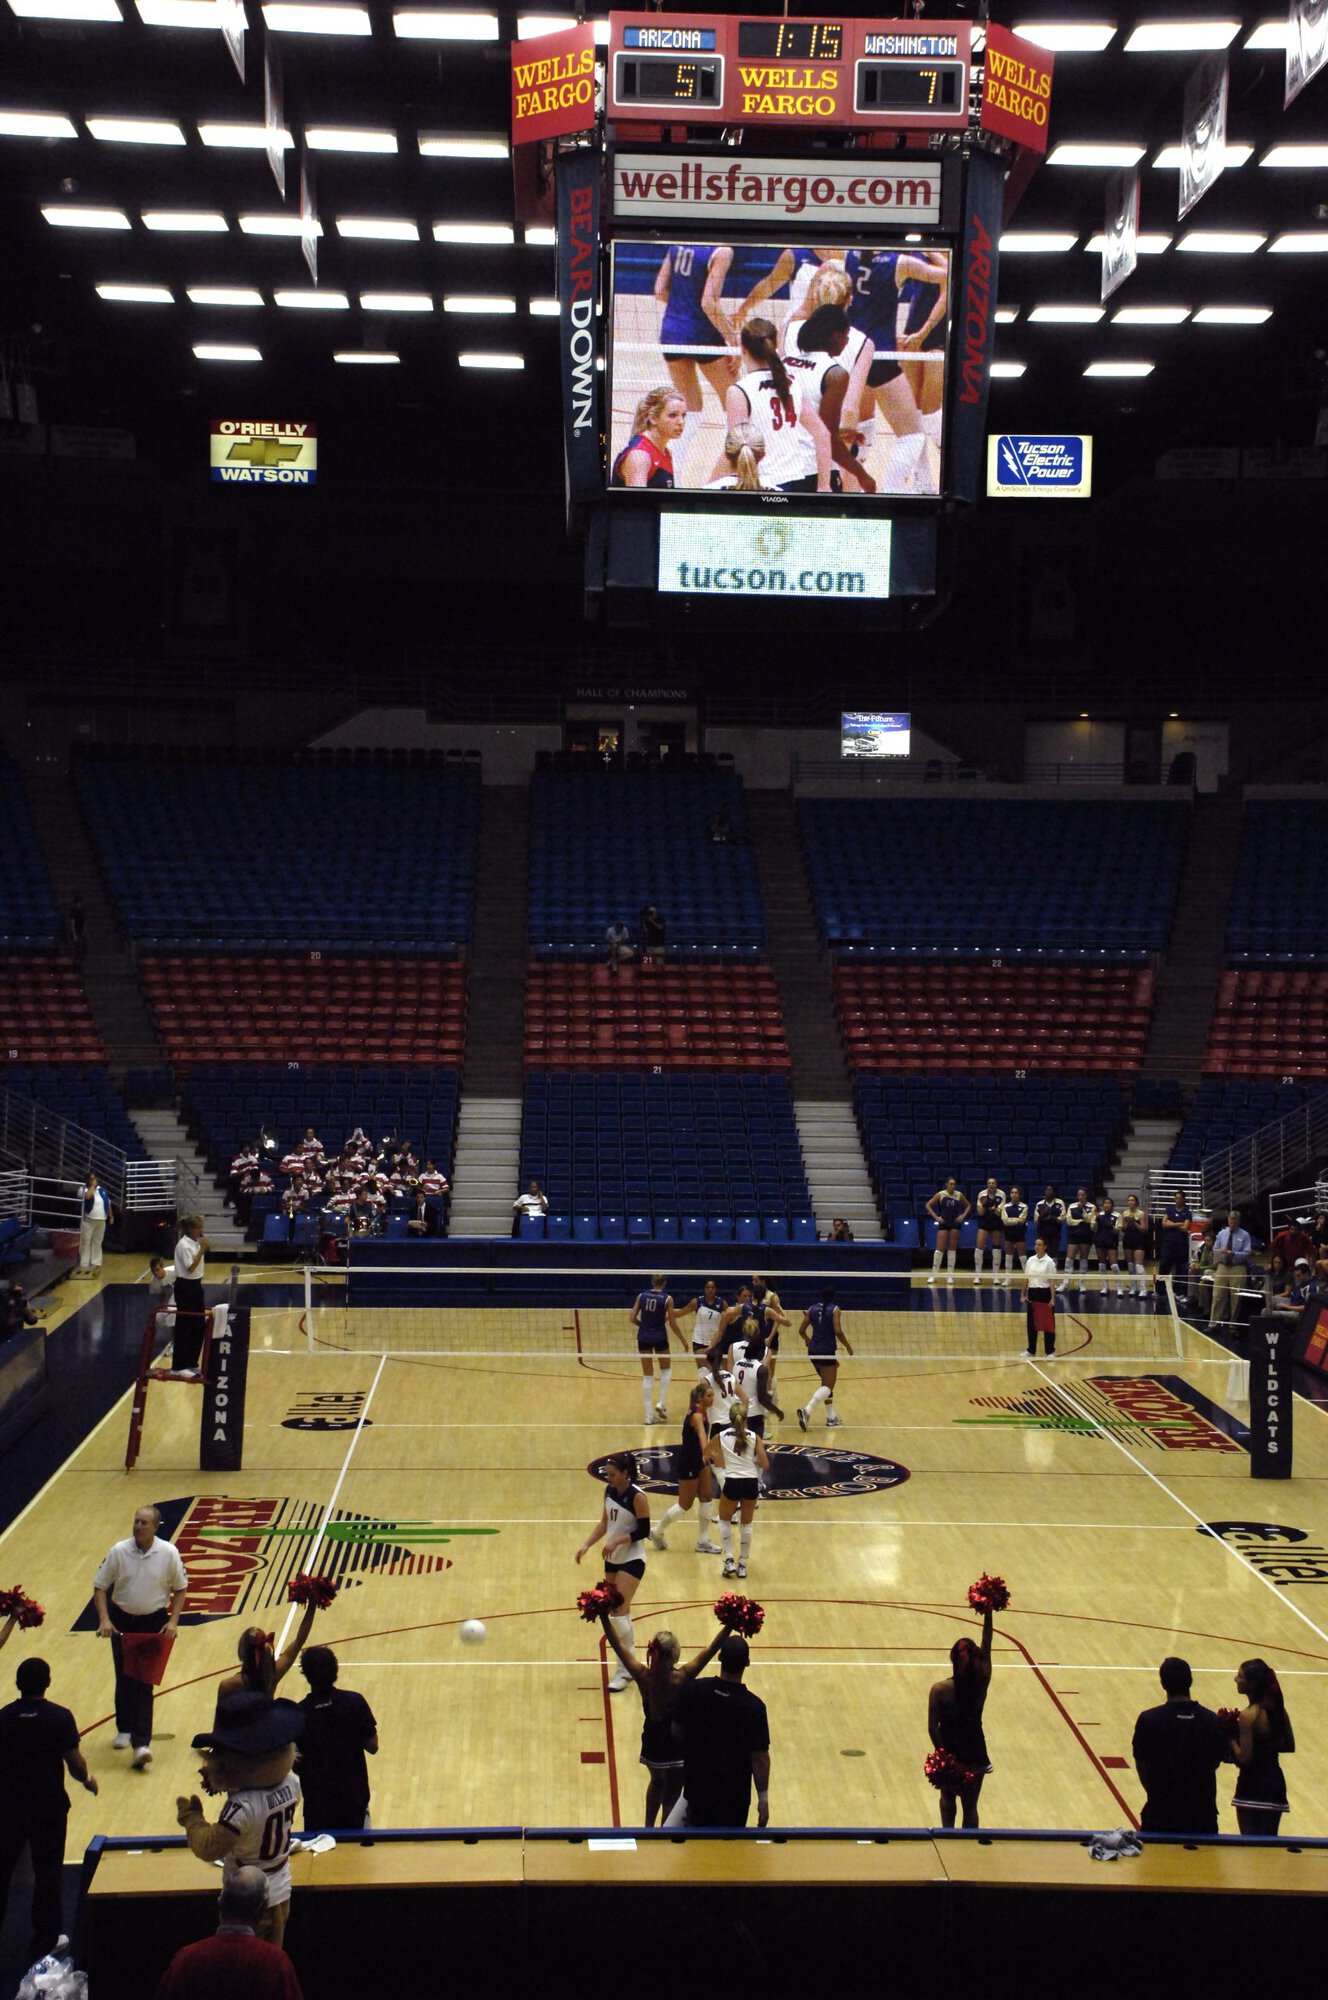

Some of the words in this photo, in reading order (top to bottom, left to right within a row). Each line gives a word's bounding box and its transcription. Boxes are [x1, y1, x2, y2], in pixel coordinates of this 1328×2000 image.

[638, 28, 701, 48] ARIZONA
[775, 23, 842, 58] 1:15
[864, 35, 958, 56] WASHINGTON
[513, 49, 595, 89] WELLS
[738, 67, 839, 89] WELLS
[987, 48, 1051, 99] WELLS
[674, 64, 696, 97] 5
[919, 71, 938, 104] 7
[515, 79, 592, 119] FARGO
[741, 93, 836, 116] FARGO
[986, 79, 1047, 126] FARGO
[620, 162, 932, 214] wellsfargo.com
[570, 186, 593, 308] BEAR
[960, 213, 992, 404] ARIZONA
[219, 421, 308, 436] O'RIELLY
[1018, 442, 1066, 454] Tucson
[1023, 454, 1075, 466] Electric
[220, 468, 309, 483] WATSON
[1027, 466, 1075, 478] Power
[676, 561, 867, 593] tucson.com
[577, 688, 603, 698] HALL
[623, 688, 688, 699] CHAMPIONS
[992, 959, 1002, 967] 22
[653, 1066, 662, 1074] 21
[1015, 1070, 1026, 1079] 22
[645, 1299, 657, 1312] 10
[707, 1311, 713, 1320] 7
[1265, 1333, 1279, 1453] WILDCATS
